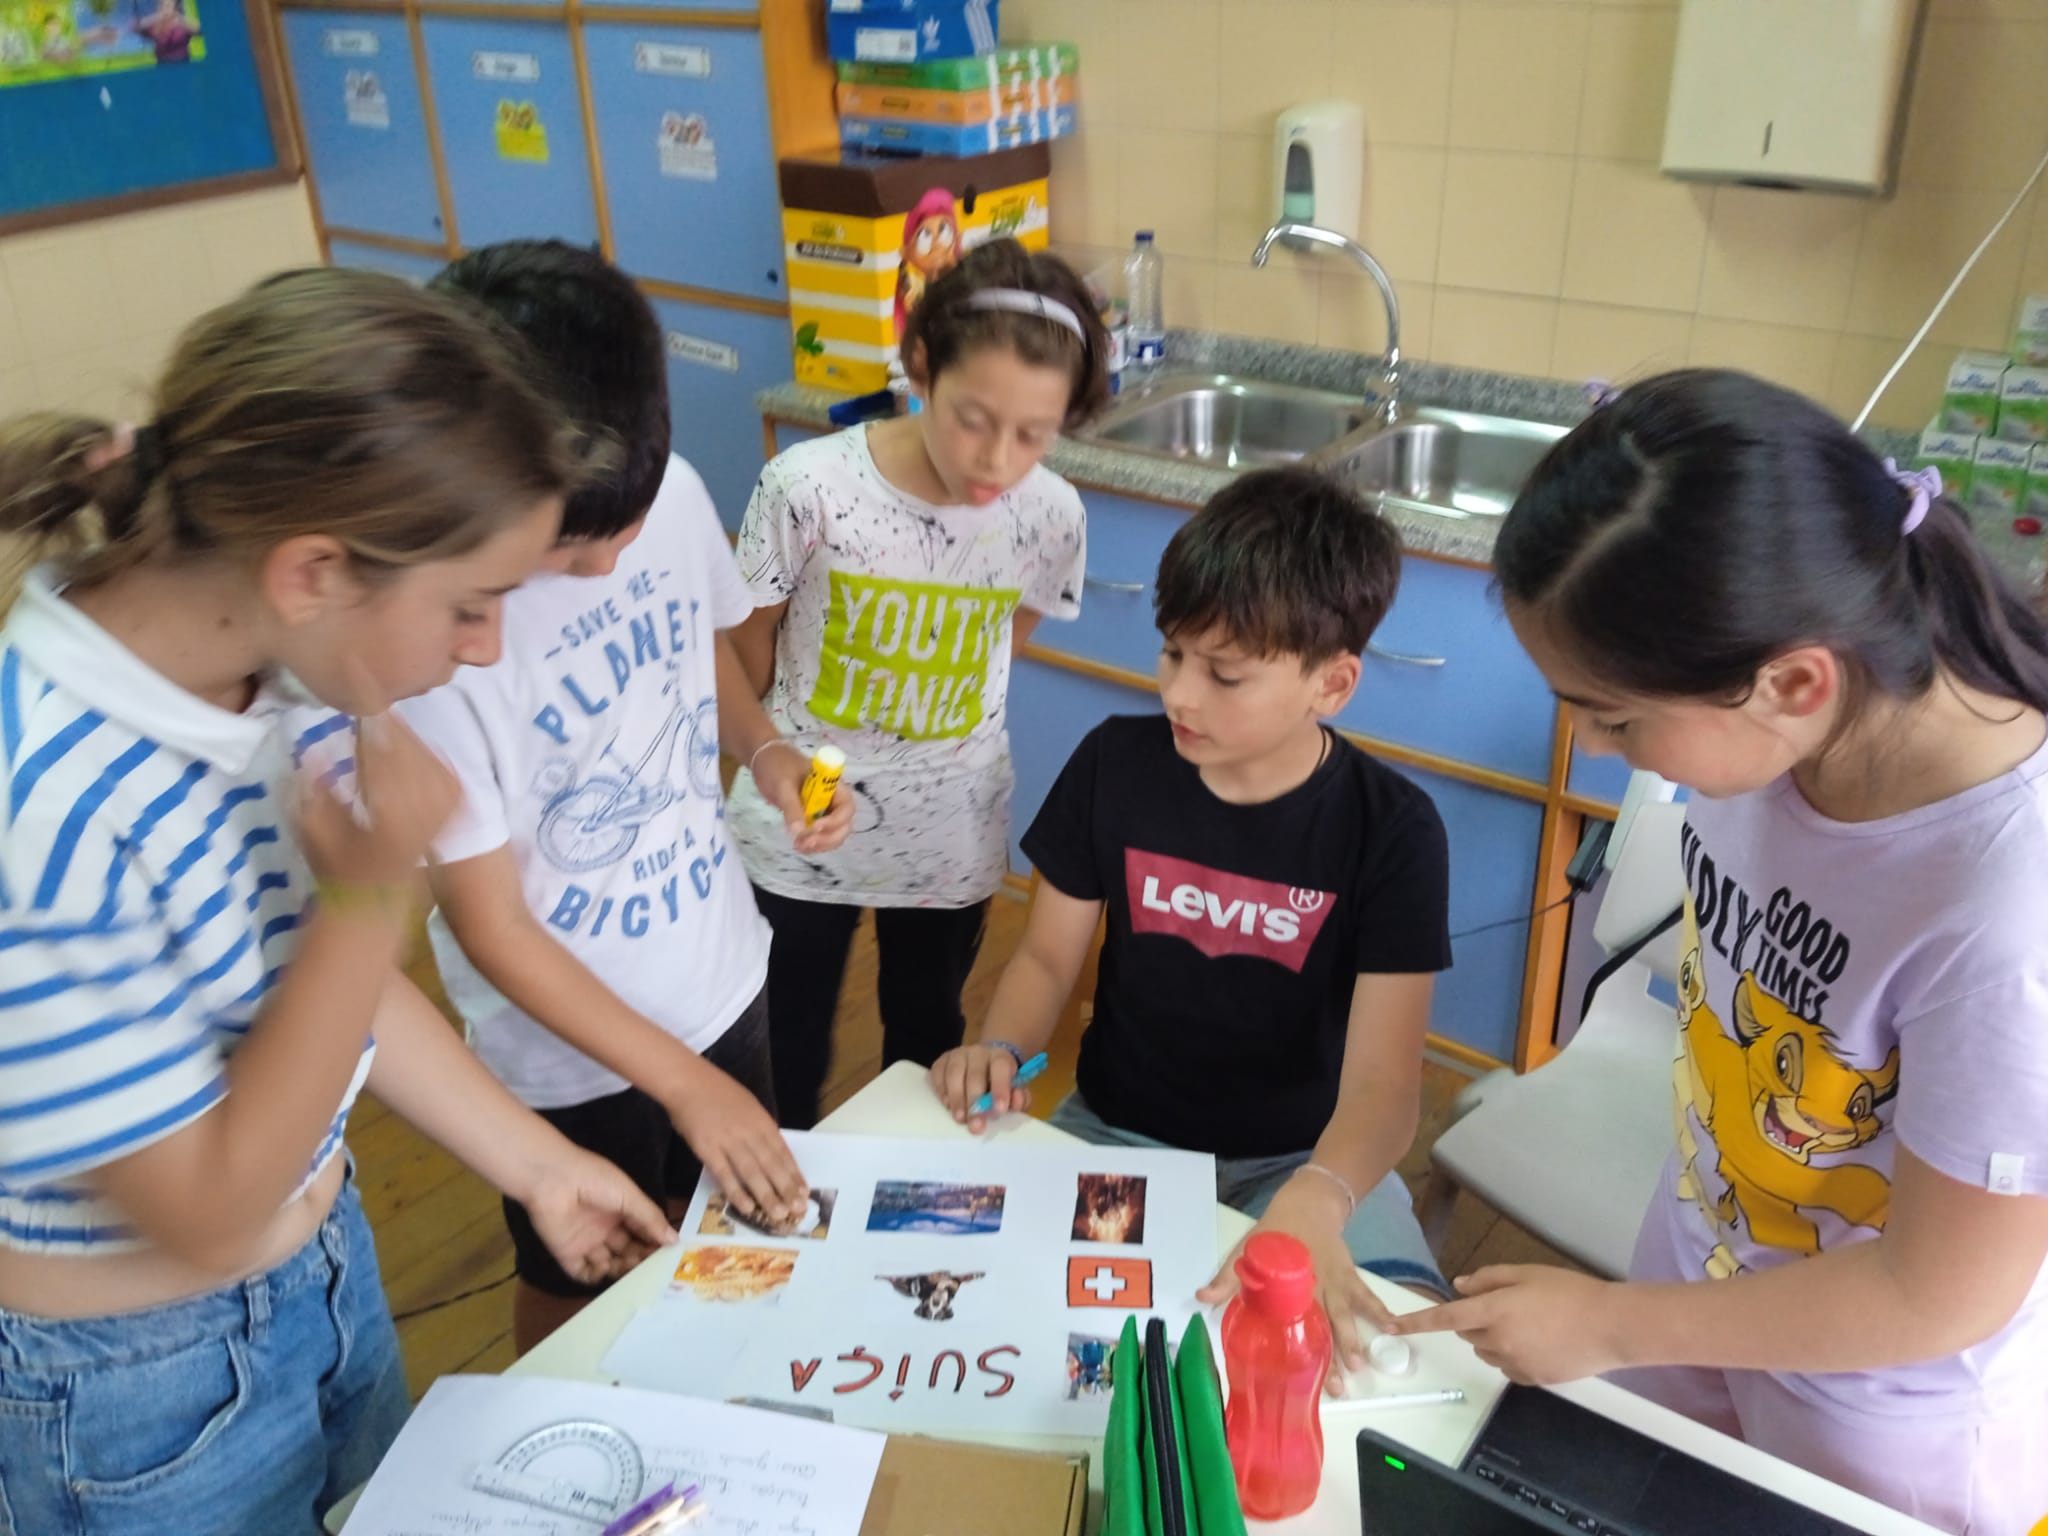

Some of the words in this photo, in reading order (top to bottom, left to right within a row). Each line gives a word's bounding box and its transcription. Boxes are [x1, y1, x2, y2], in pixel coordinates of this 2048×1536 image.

[561, 598, 623, 648] SAVE
[840, 583, 1015, 664] YOUTH
[833, 654, 979, 735] TONIC
[683, 827, 697, 850] A
[1765, 886, 1850, 986] GOOD
[1753, 934, 1830, 1025] TIMES
